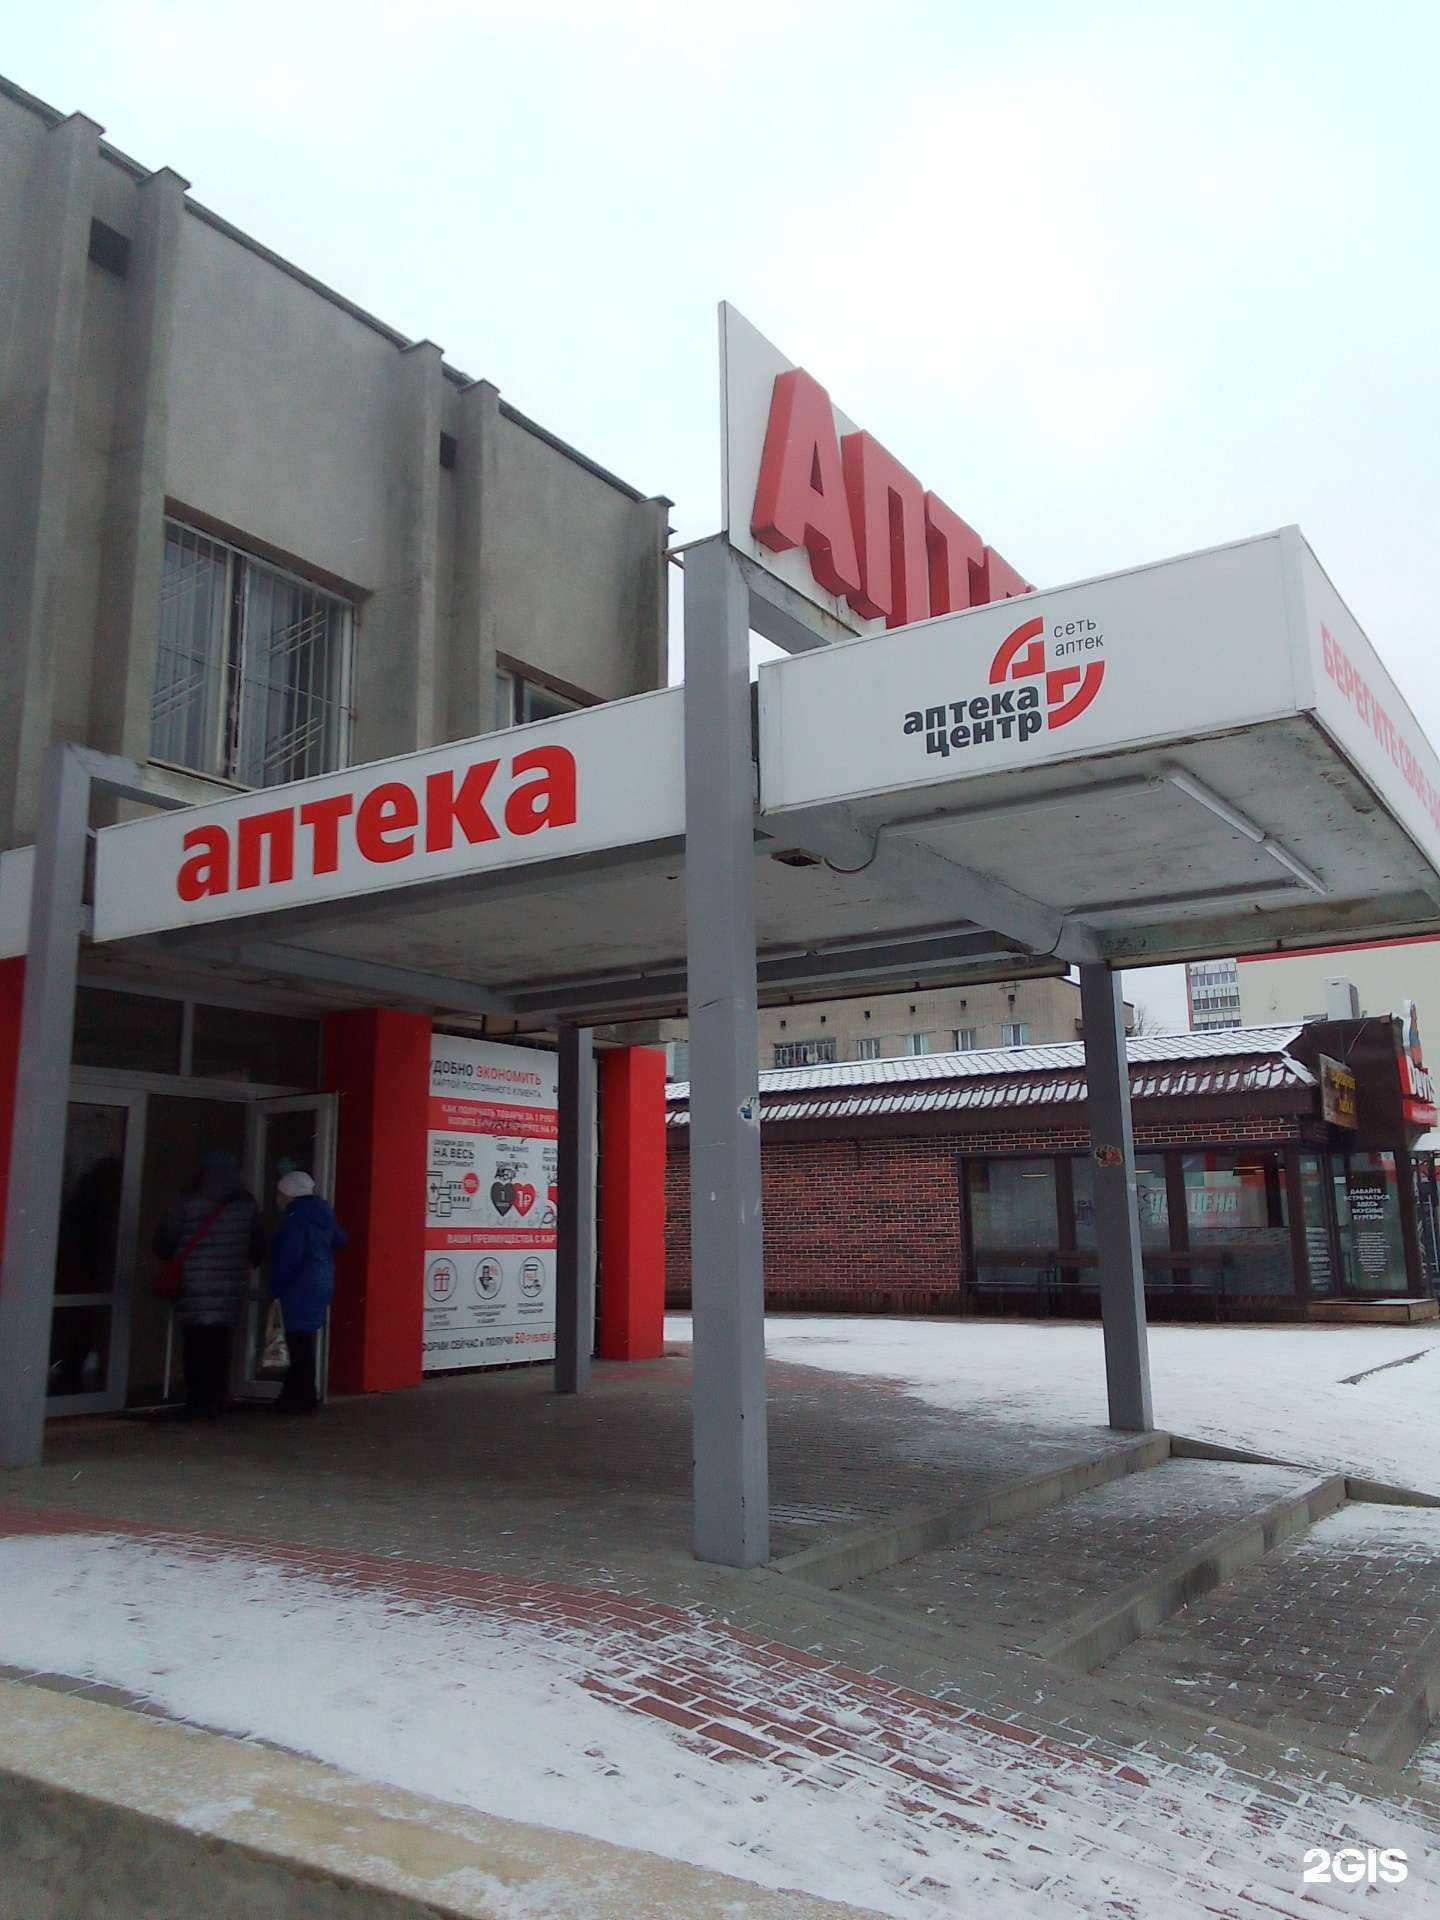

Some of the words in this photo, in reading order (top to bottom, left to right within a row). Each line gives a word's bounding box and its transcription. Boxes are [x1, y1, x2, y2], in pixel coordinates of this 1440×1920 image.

[751, 366, 1037, 630] АПТ
[1053, 617, 1096, 638] сеть
[1055, 633, 1104, 657] аптек
[903, 685, 1039, 735] аптека
[926, 710, 1042, 758] центр
[176, 744, 577, 902] аптека
[475, 1065, 542, 1085] ЭКОНОМИТЬ
